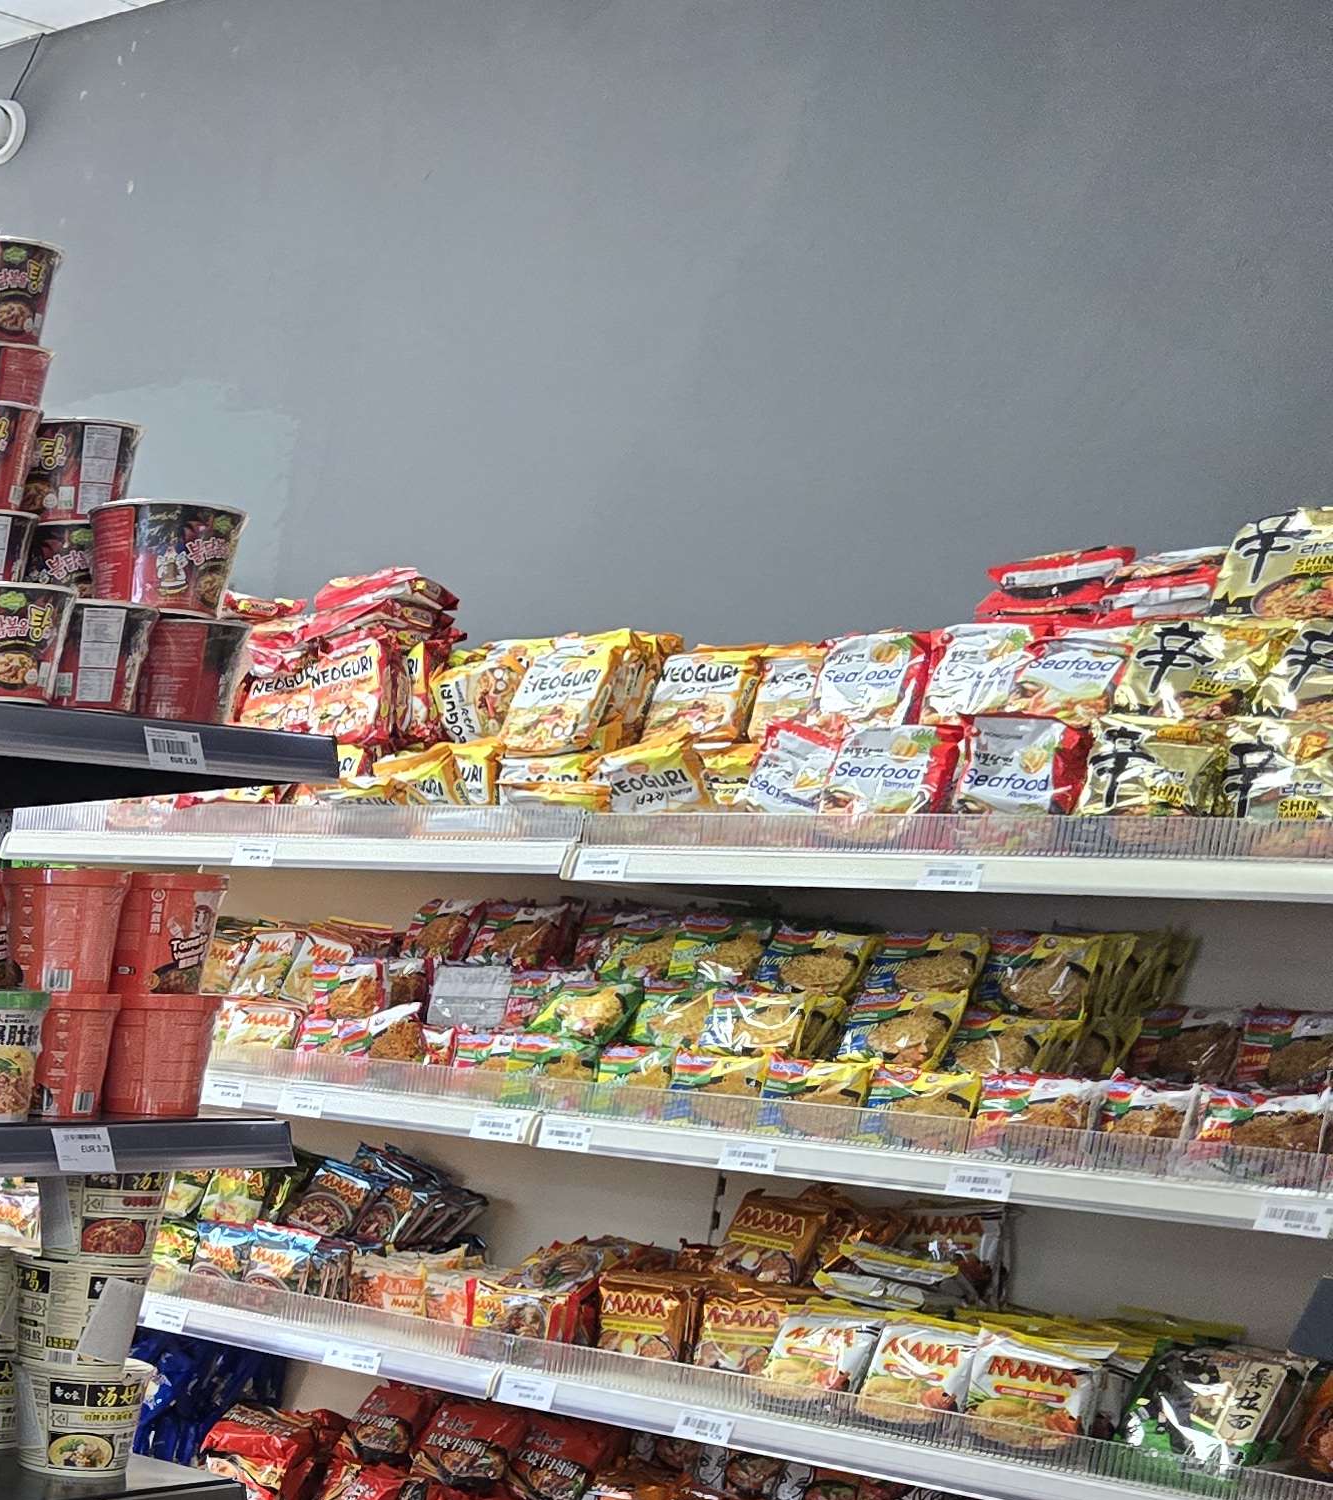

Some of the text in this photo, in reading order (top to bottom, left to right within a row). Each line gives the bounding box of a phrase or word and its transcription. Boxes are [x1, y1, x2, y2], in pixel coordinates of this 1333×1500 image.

[310, 656, 374, 688] NEOGURI
[1030, 656, 1117, 673] Seafood
[1136, 624, 1215, 696] 辛
[529, 668, 602, 694] NEOGURI
[657, 664, 741, 685] NEOGURI
[835, 761, 921, 781] Seafood
[965, 769, 1049, 792] Seafood
[1149, 785, 1185, 802] SHIN
[1279, 799, 1319, 814] SHIN
[242, 1012, 295, 1029] MAMA
[319, 1171, 365, 1202] MAMA
[733, 1205, 806, 1238] MAMA
[602, 1292, 669, 1318] MAMA
[988, 1355, 1079, 1390] MAMA
